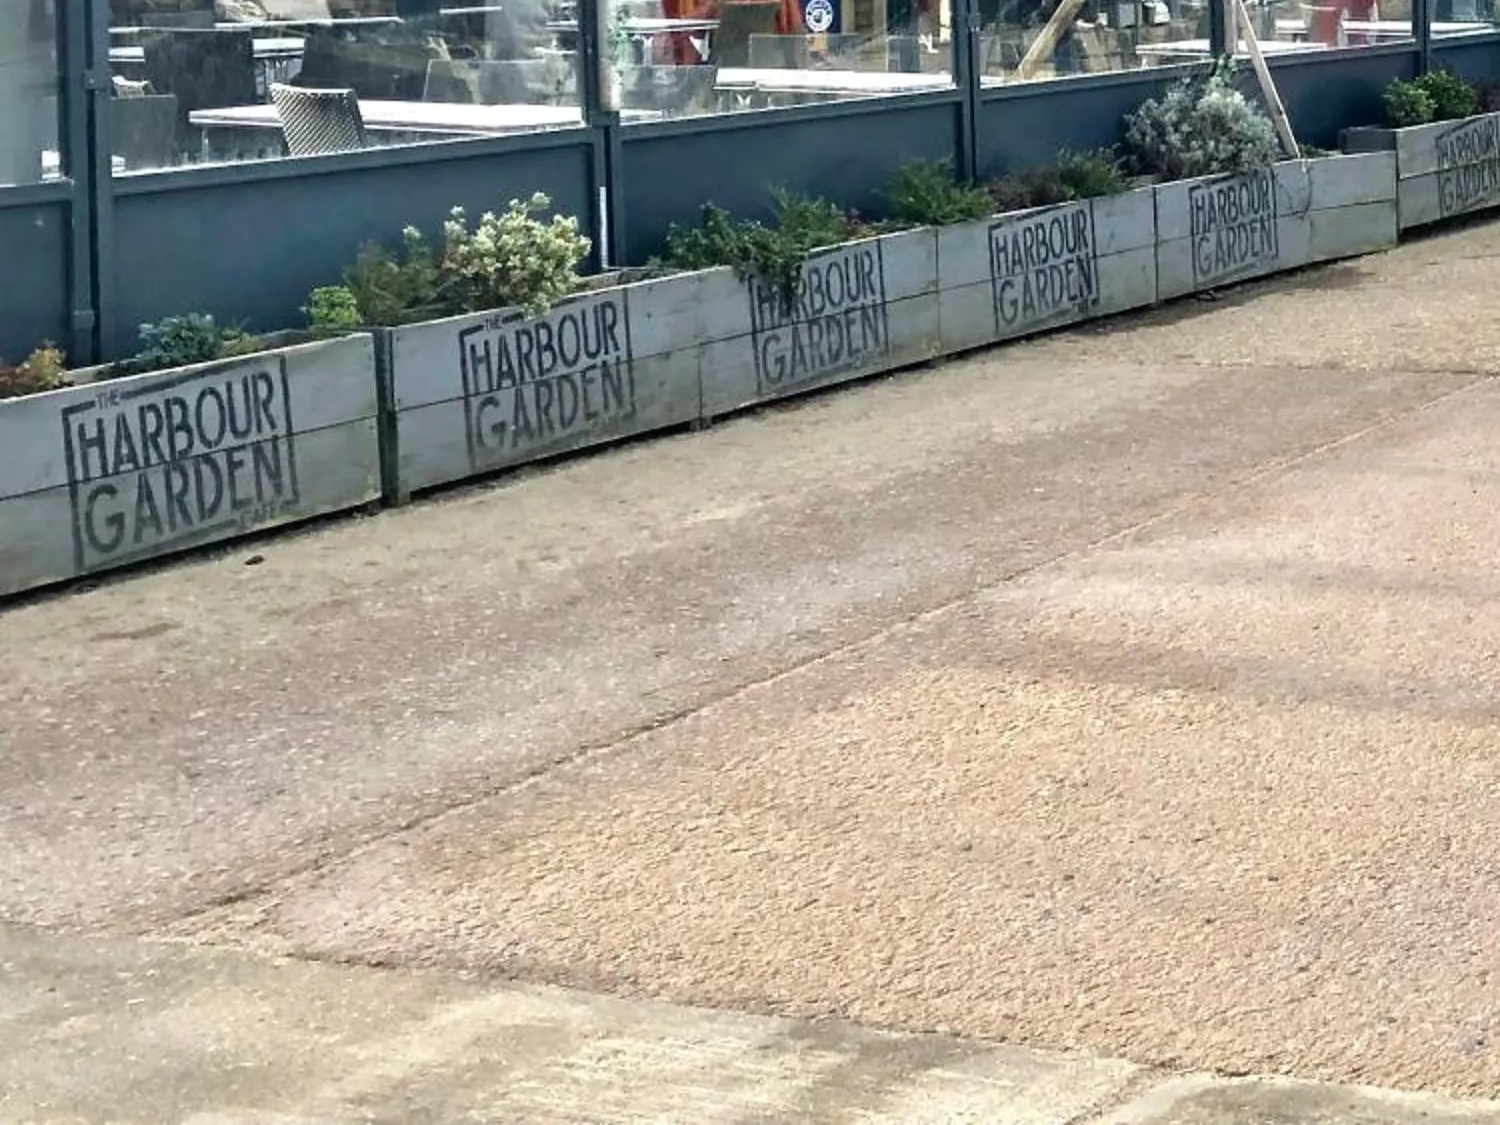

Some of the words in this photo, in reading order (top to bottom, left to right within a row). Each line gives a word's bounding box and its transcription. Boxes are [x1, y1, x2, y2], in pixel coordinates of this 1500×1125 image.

[1195, 176, 1271, 235] HARBOUR
[1442, 157, 1499, 212] GARDEN
[995, 208, 1088, 276] HARBOUR
[1198, 213, 1273, 275] GARDEN
[1000, 253, 1093, 324] GARDEN
[470, 300, 620, 393] HARBOUR
[762, 300, 881, 385] GARDEN
[78, 371, 277, 480] HARBOUR
[97, 388, 120, 410] THE
[475, 355, 625, 449] GARDEN
[84, 435, 284, 553] GARDEN
